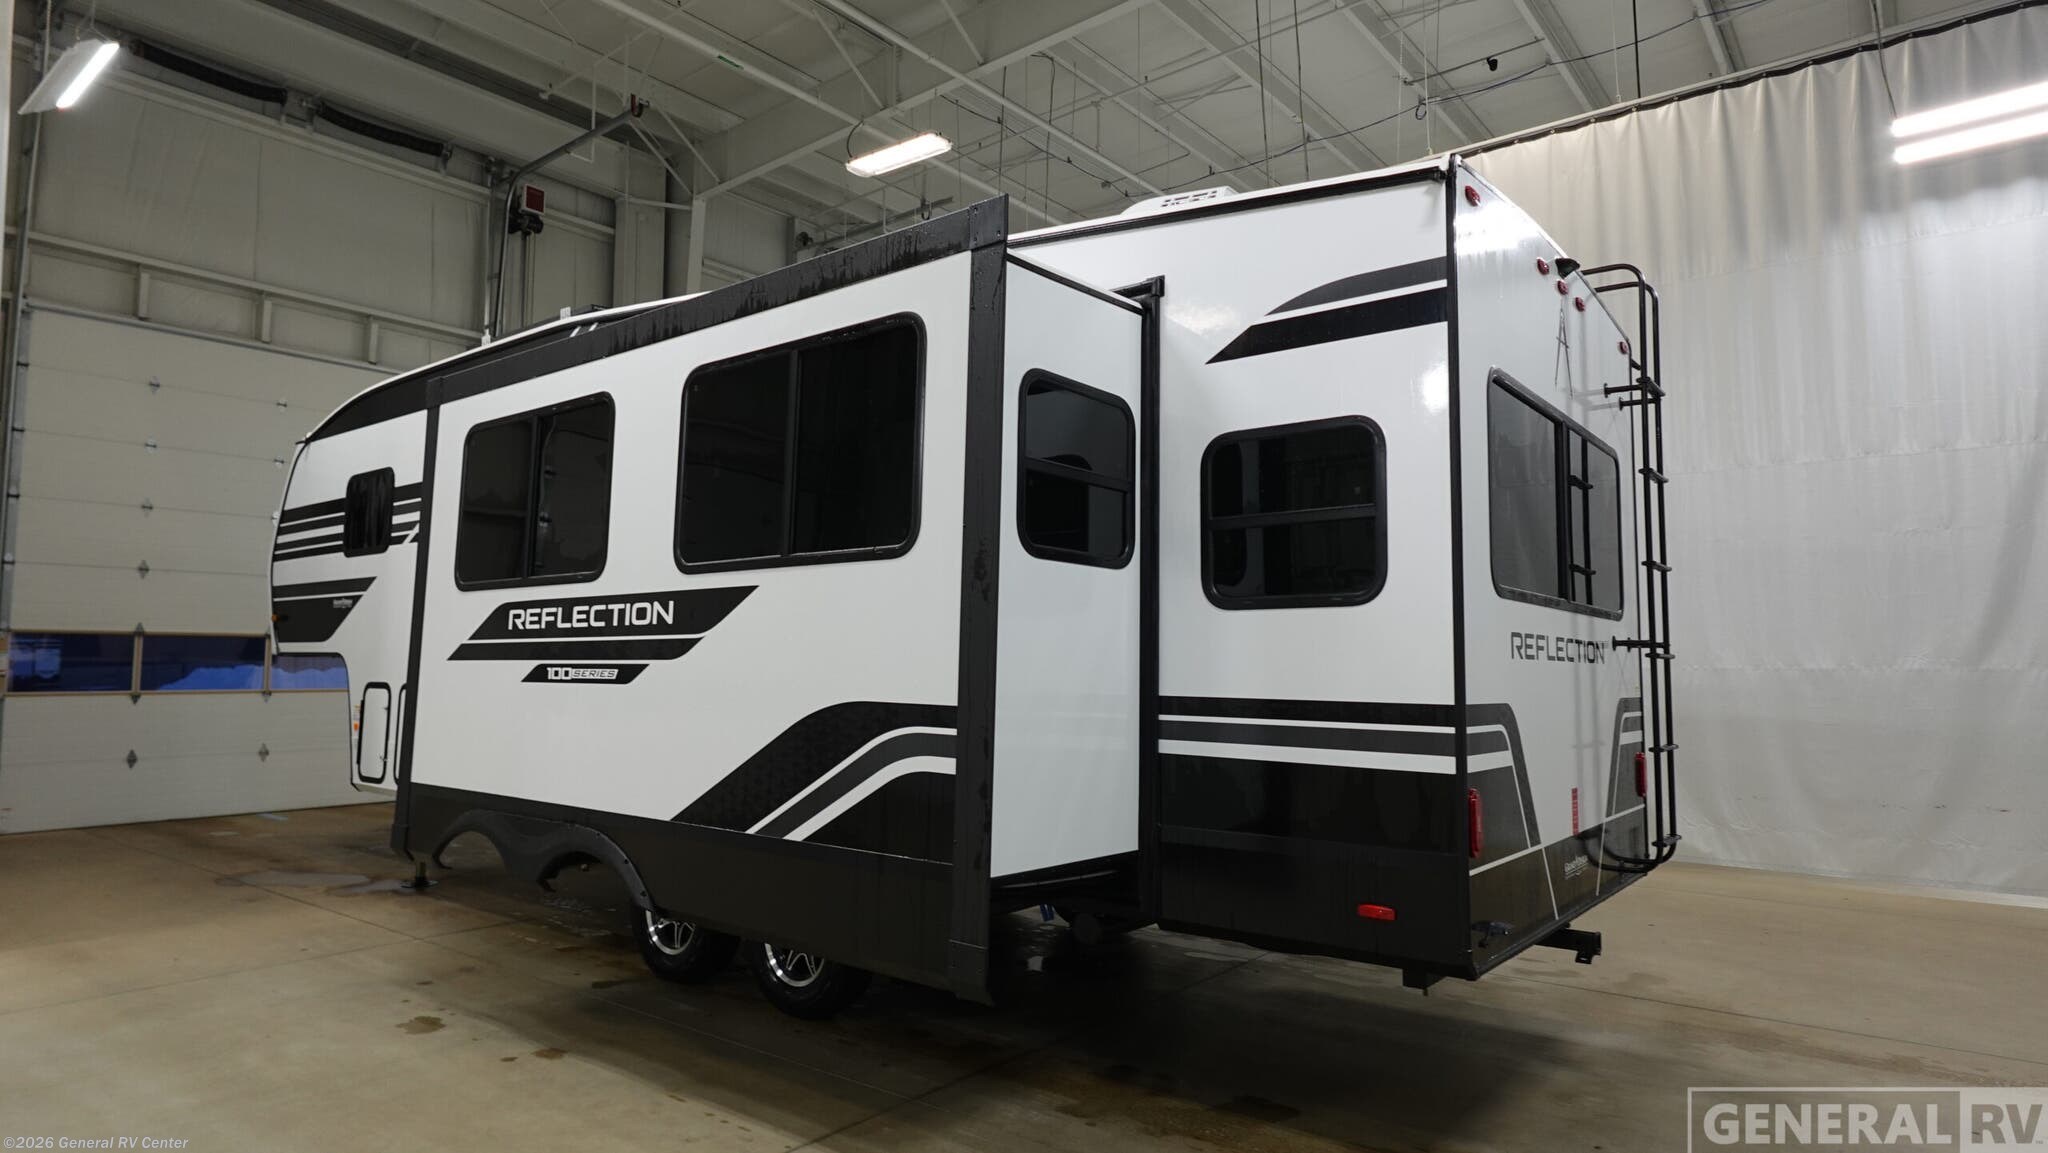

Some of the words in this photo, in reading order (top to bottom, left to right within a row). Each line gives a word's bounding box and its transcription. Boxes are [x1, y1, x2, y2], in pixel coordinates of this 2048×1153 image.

[508, 600, 675, 631] REFLECTION
[1511, 631, 1605, 664] REFLECTION
[547, 667, 572, 680] 100
[572, 668, 618, 680] SERIES
